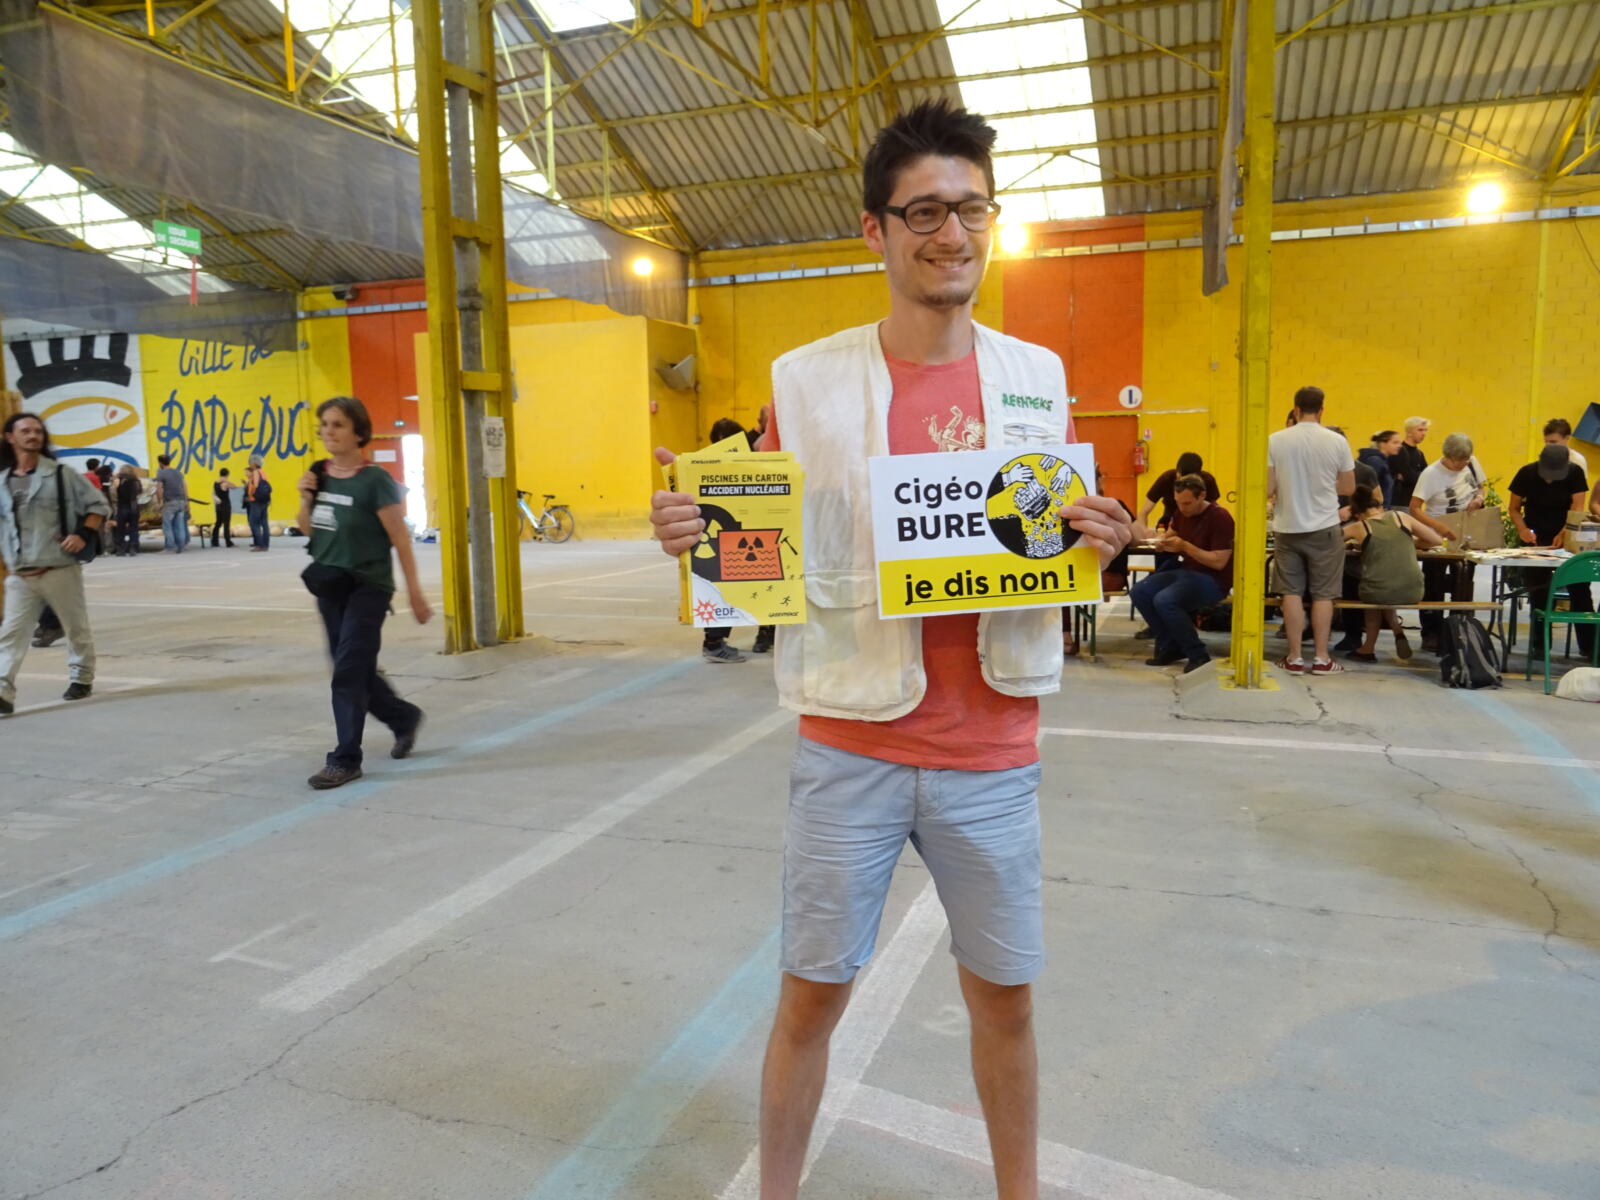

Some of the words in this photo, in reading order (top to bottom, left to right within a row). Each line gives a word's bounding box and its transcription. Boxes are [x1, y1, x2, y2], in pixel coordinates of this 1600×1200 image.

[156, 389, 231, 475] BAR
[231, 409, 255, 453] LE
[250, 394, 308, 460] DUC
[701, 474, 739, 483] PISCINES
[741, 474, 753, 482] EN
[755, 473, 788, 482] CARTON
[708, 486, 743, 494] ACCIDENT
[897, 512, 986, 541] BURE
[905, 573, 933, 606] je
[944, 570, 989, 597] dis
[1000, 570, 1059, 593] non
[1068, 564, 1075, 588] !
